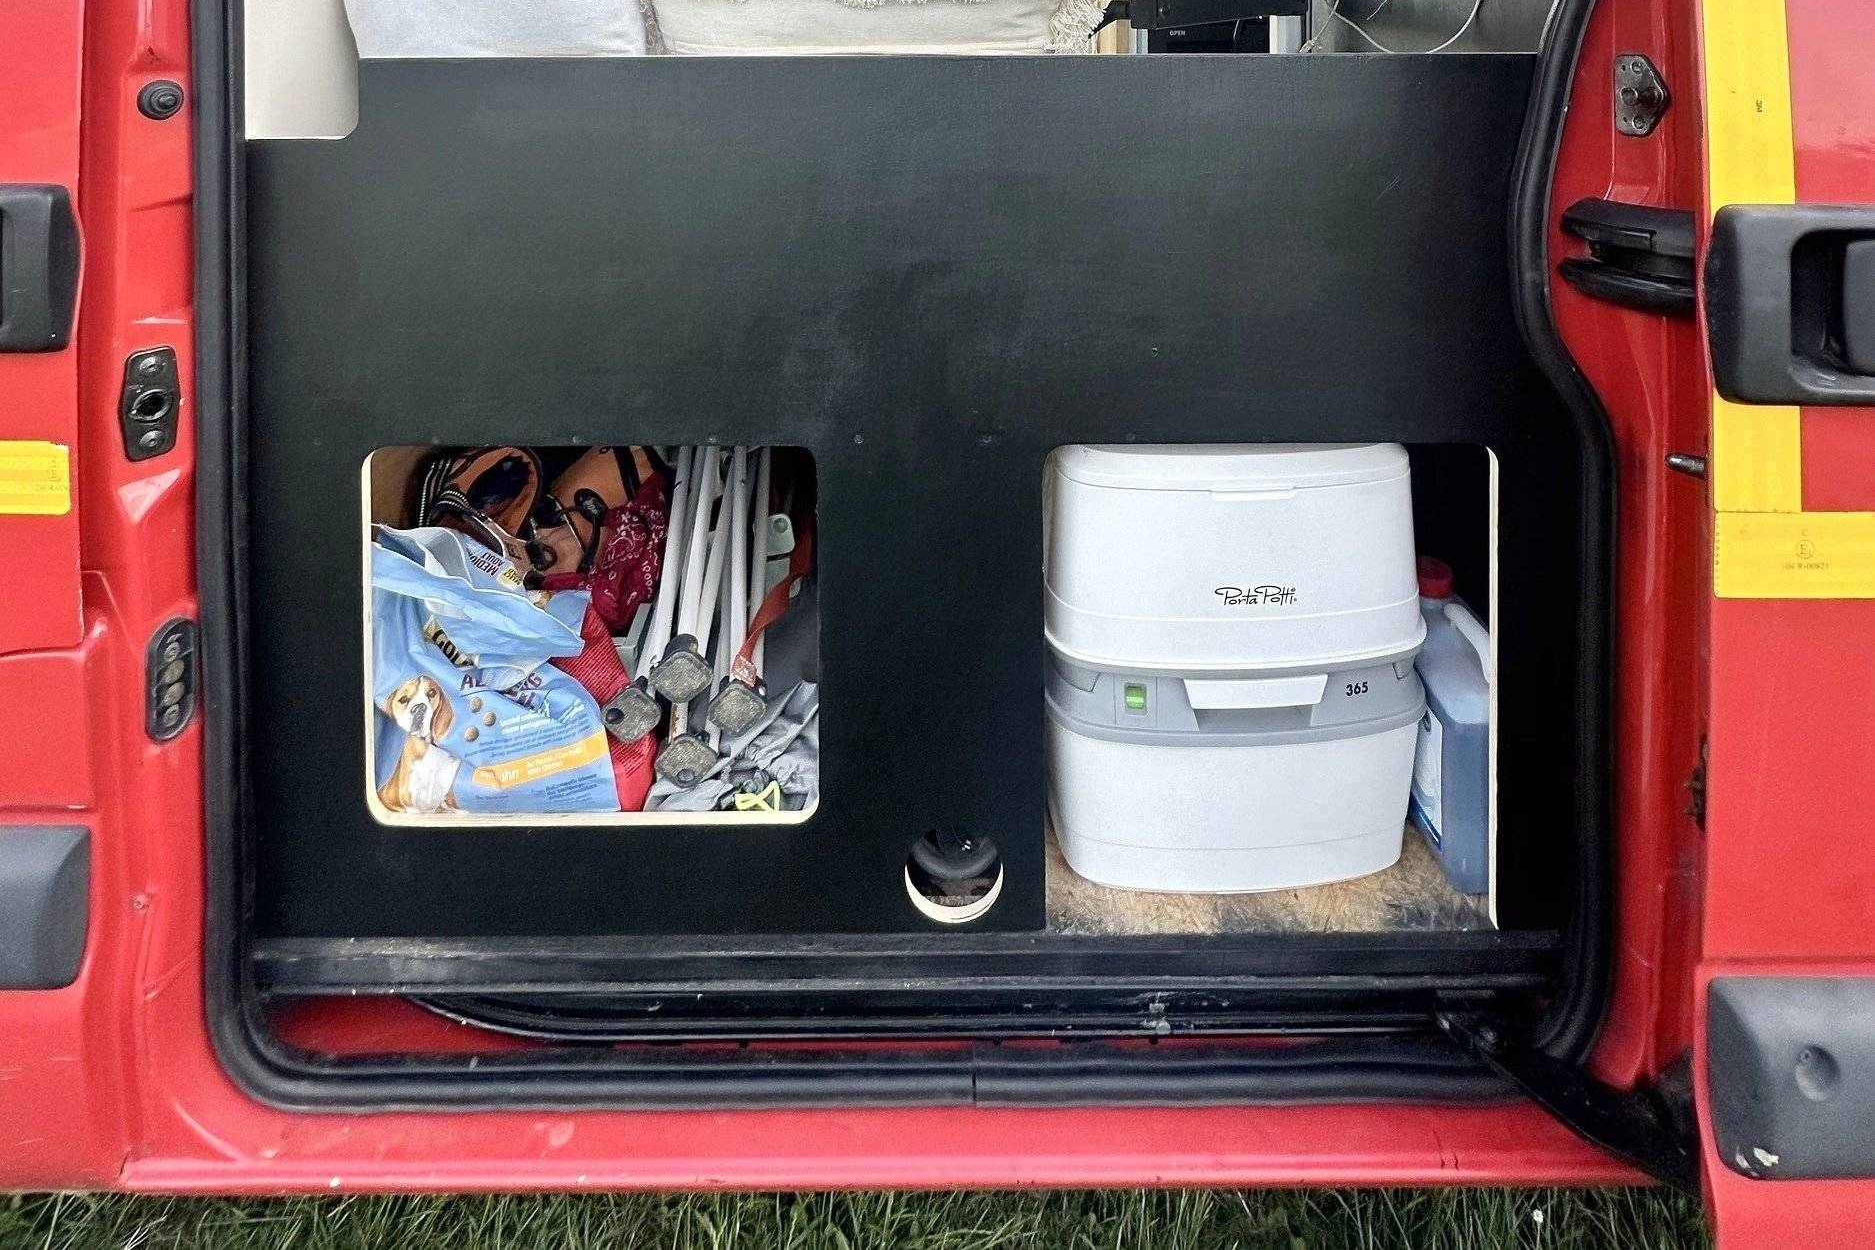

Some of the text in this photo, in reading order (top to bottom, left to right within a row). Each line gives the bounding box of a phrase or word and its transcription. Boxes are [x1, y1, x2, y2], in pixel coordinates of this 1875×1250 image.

[1214, 585, 1296, 606] Porta Potti
[1345, 681, 1369, 697] 365
